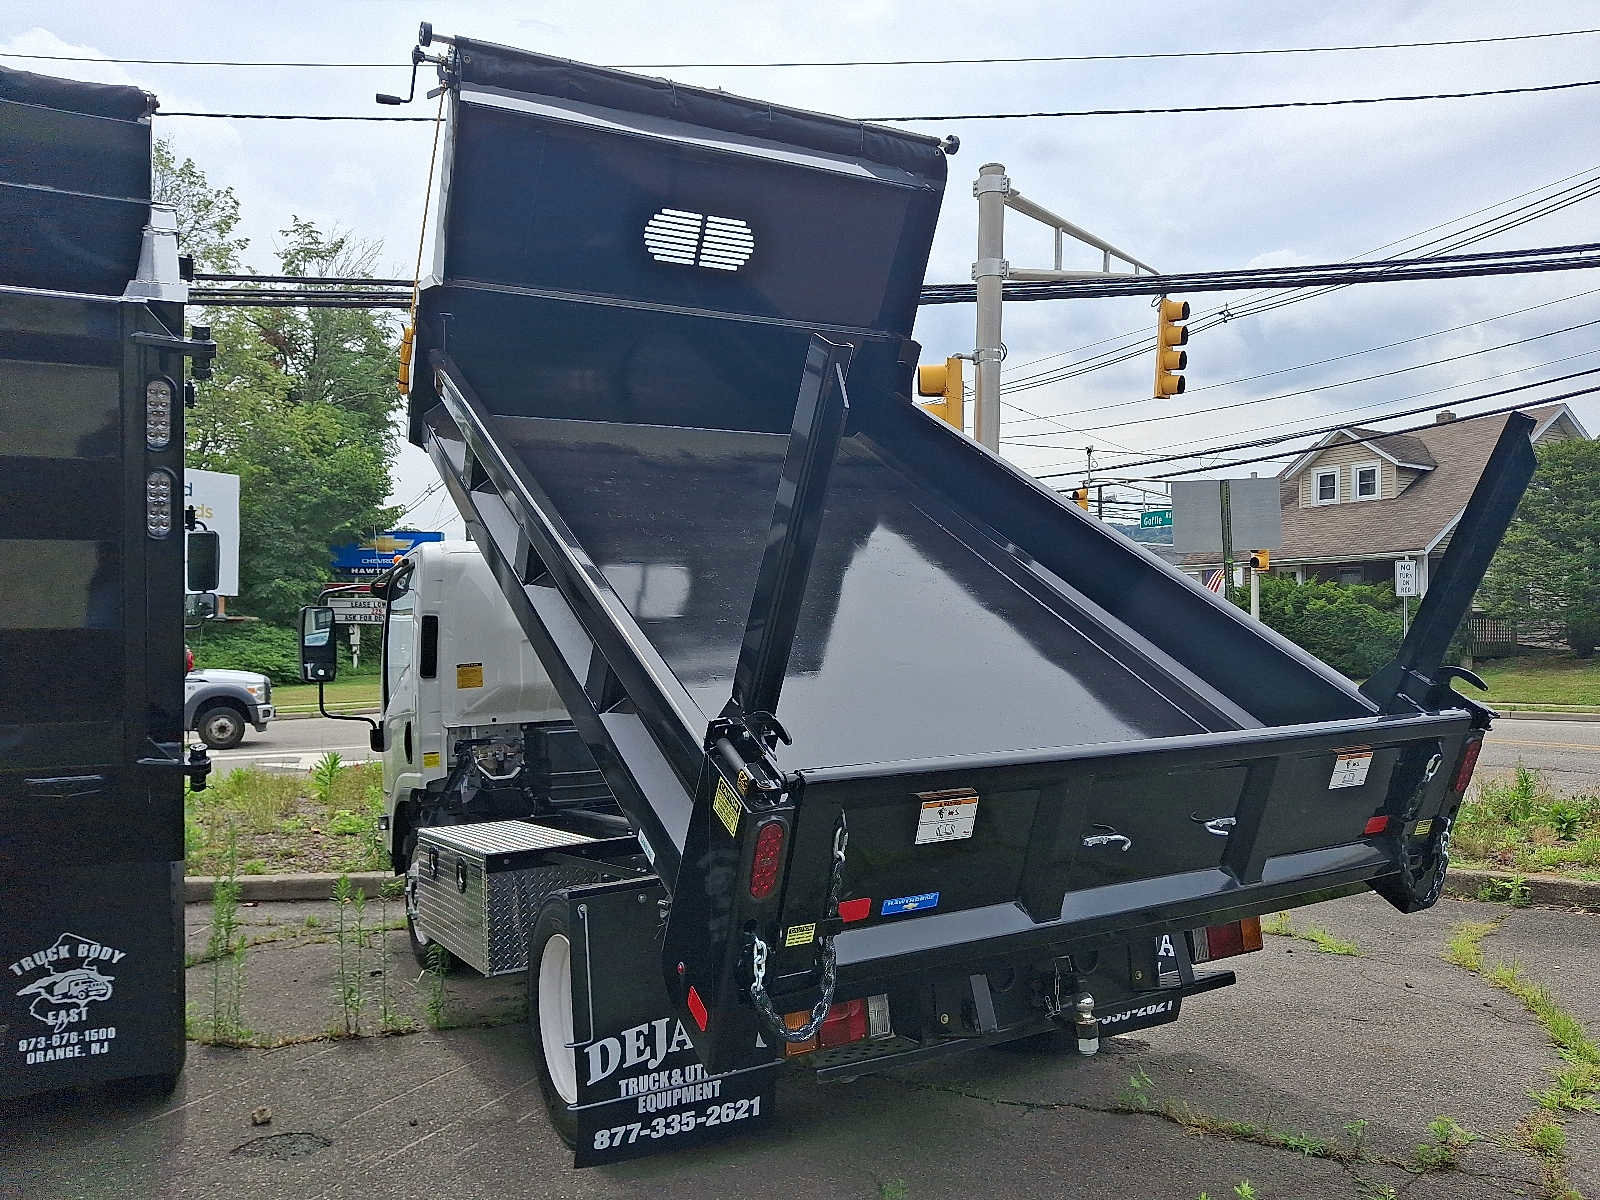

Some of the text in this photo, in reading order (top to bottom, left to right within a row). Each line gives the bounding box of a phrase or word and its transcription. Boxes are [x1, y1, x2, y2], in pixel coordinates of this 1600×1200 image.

[8, 944, 126, 976] TRUCK BODY
[47, 1007, 89, 1026] EAST
[90, 1042, 109, 1055] NJ
[638, 1079, 722, 1114] EQUIPMENT
[593, 1095, 761, 1150] 877-335-2621
